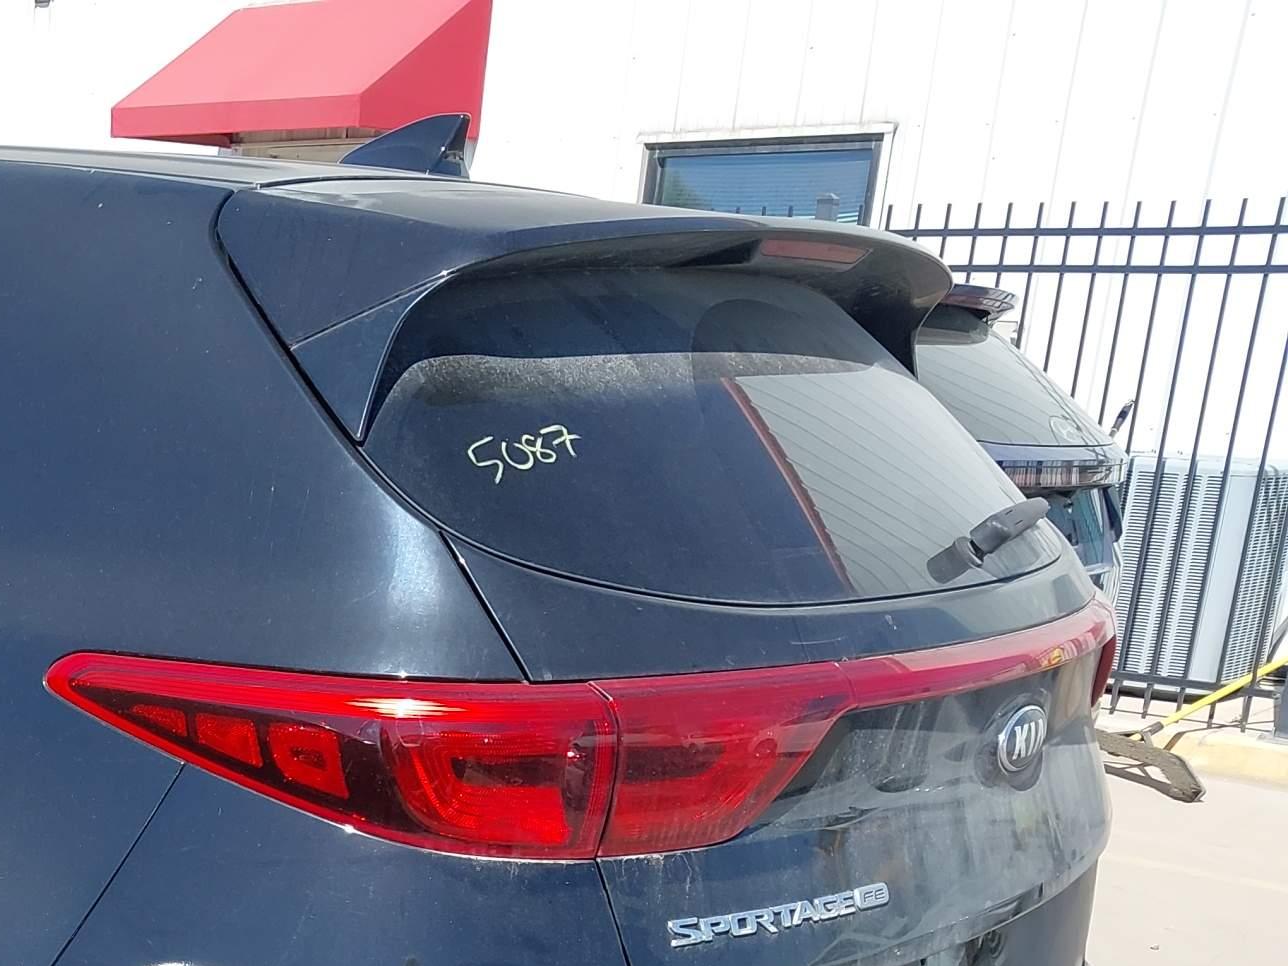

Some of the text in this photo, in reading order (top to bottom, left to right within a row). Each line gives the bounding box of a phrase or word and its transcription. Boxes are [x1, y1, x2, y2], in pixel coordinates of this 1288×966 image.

[468, 424, 582, 485] 5087
[1012, 718, 1045, 760] KIA
[668, 890, 856, 947] SPORTAGE
